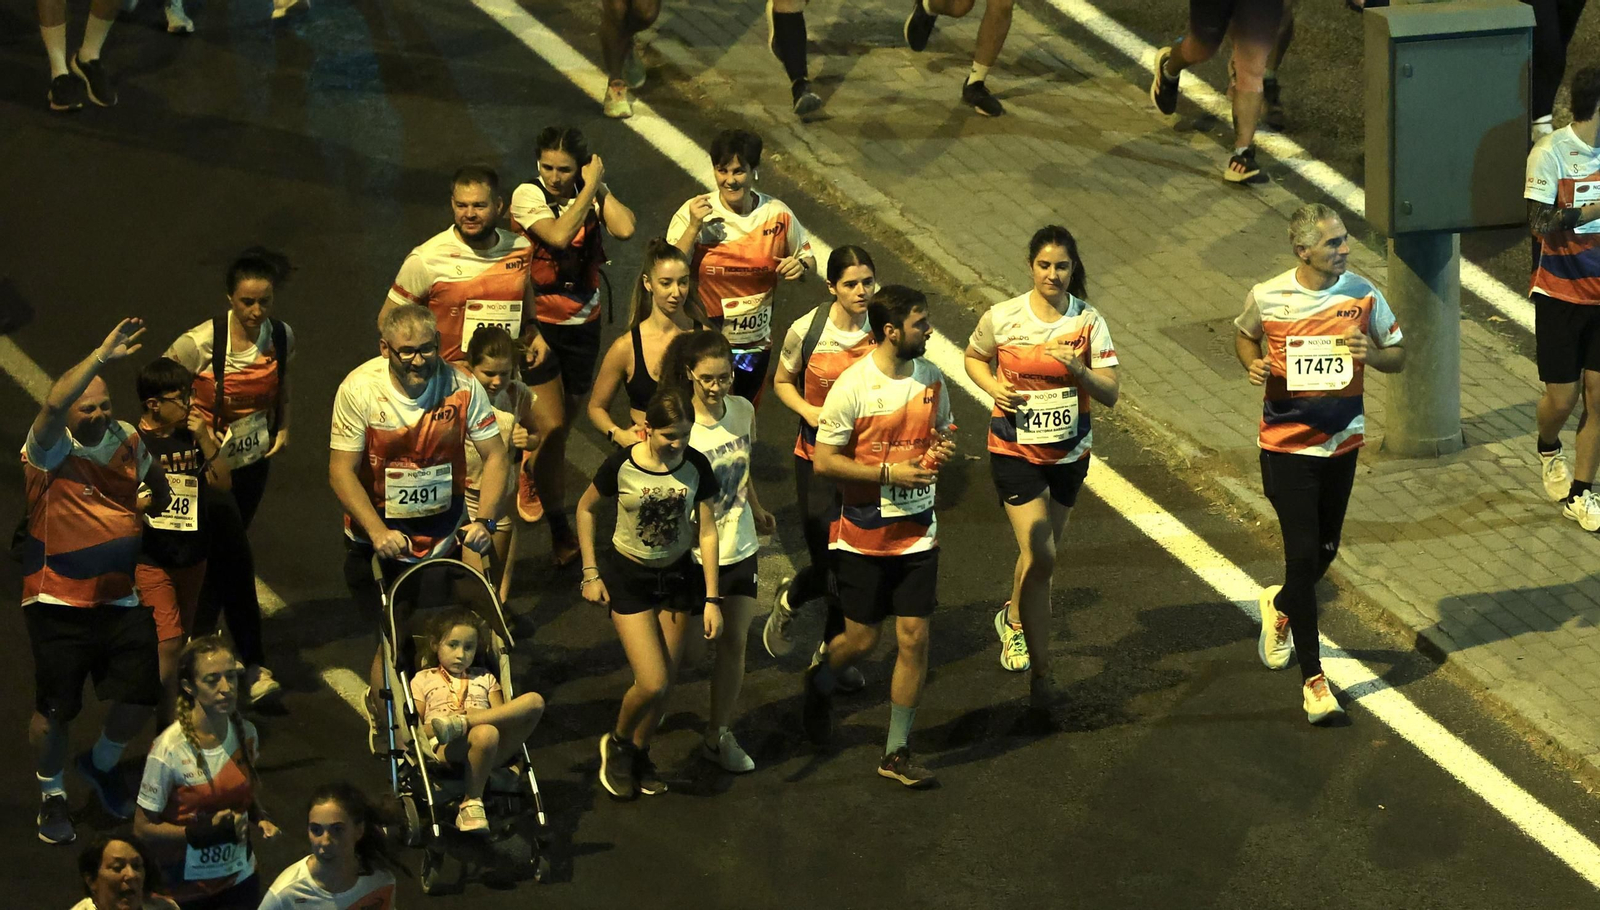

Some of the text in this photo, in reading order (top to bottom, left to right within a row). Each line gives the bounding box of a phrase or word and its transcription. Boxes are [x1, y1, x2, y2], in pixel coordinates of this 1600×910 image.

[705, 266, 725, 275] 37
[731, 308, 768, 331] 14035
[1295, 358, 1344, 374] 17473
[1024, 409, 1071, 428] 14786
[227, 432, 260, 458] 2494
[398, 486, 438, 505] 2491
[183, 772, 194, 780] NO
